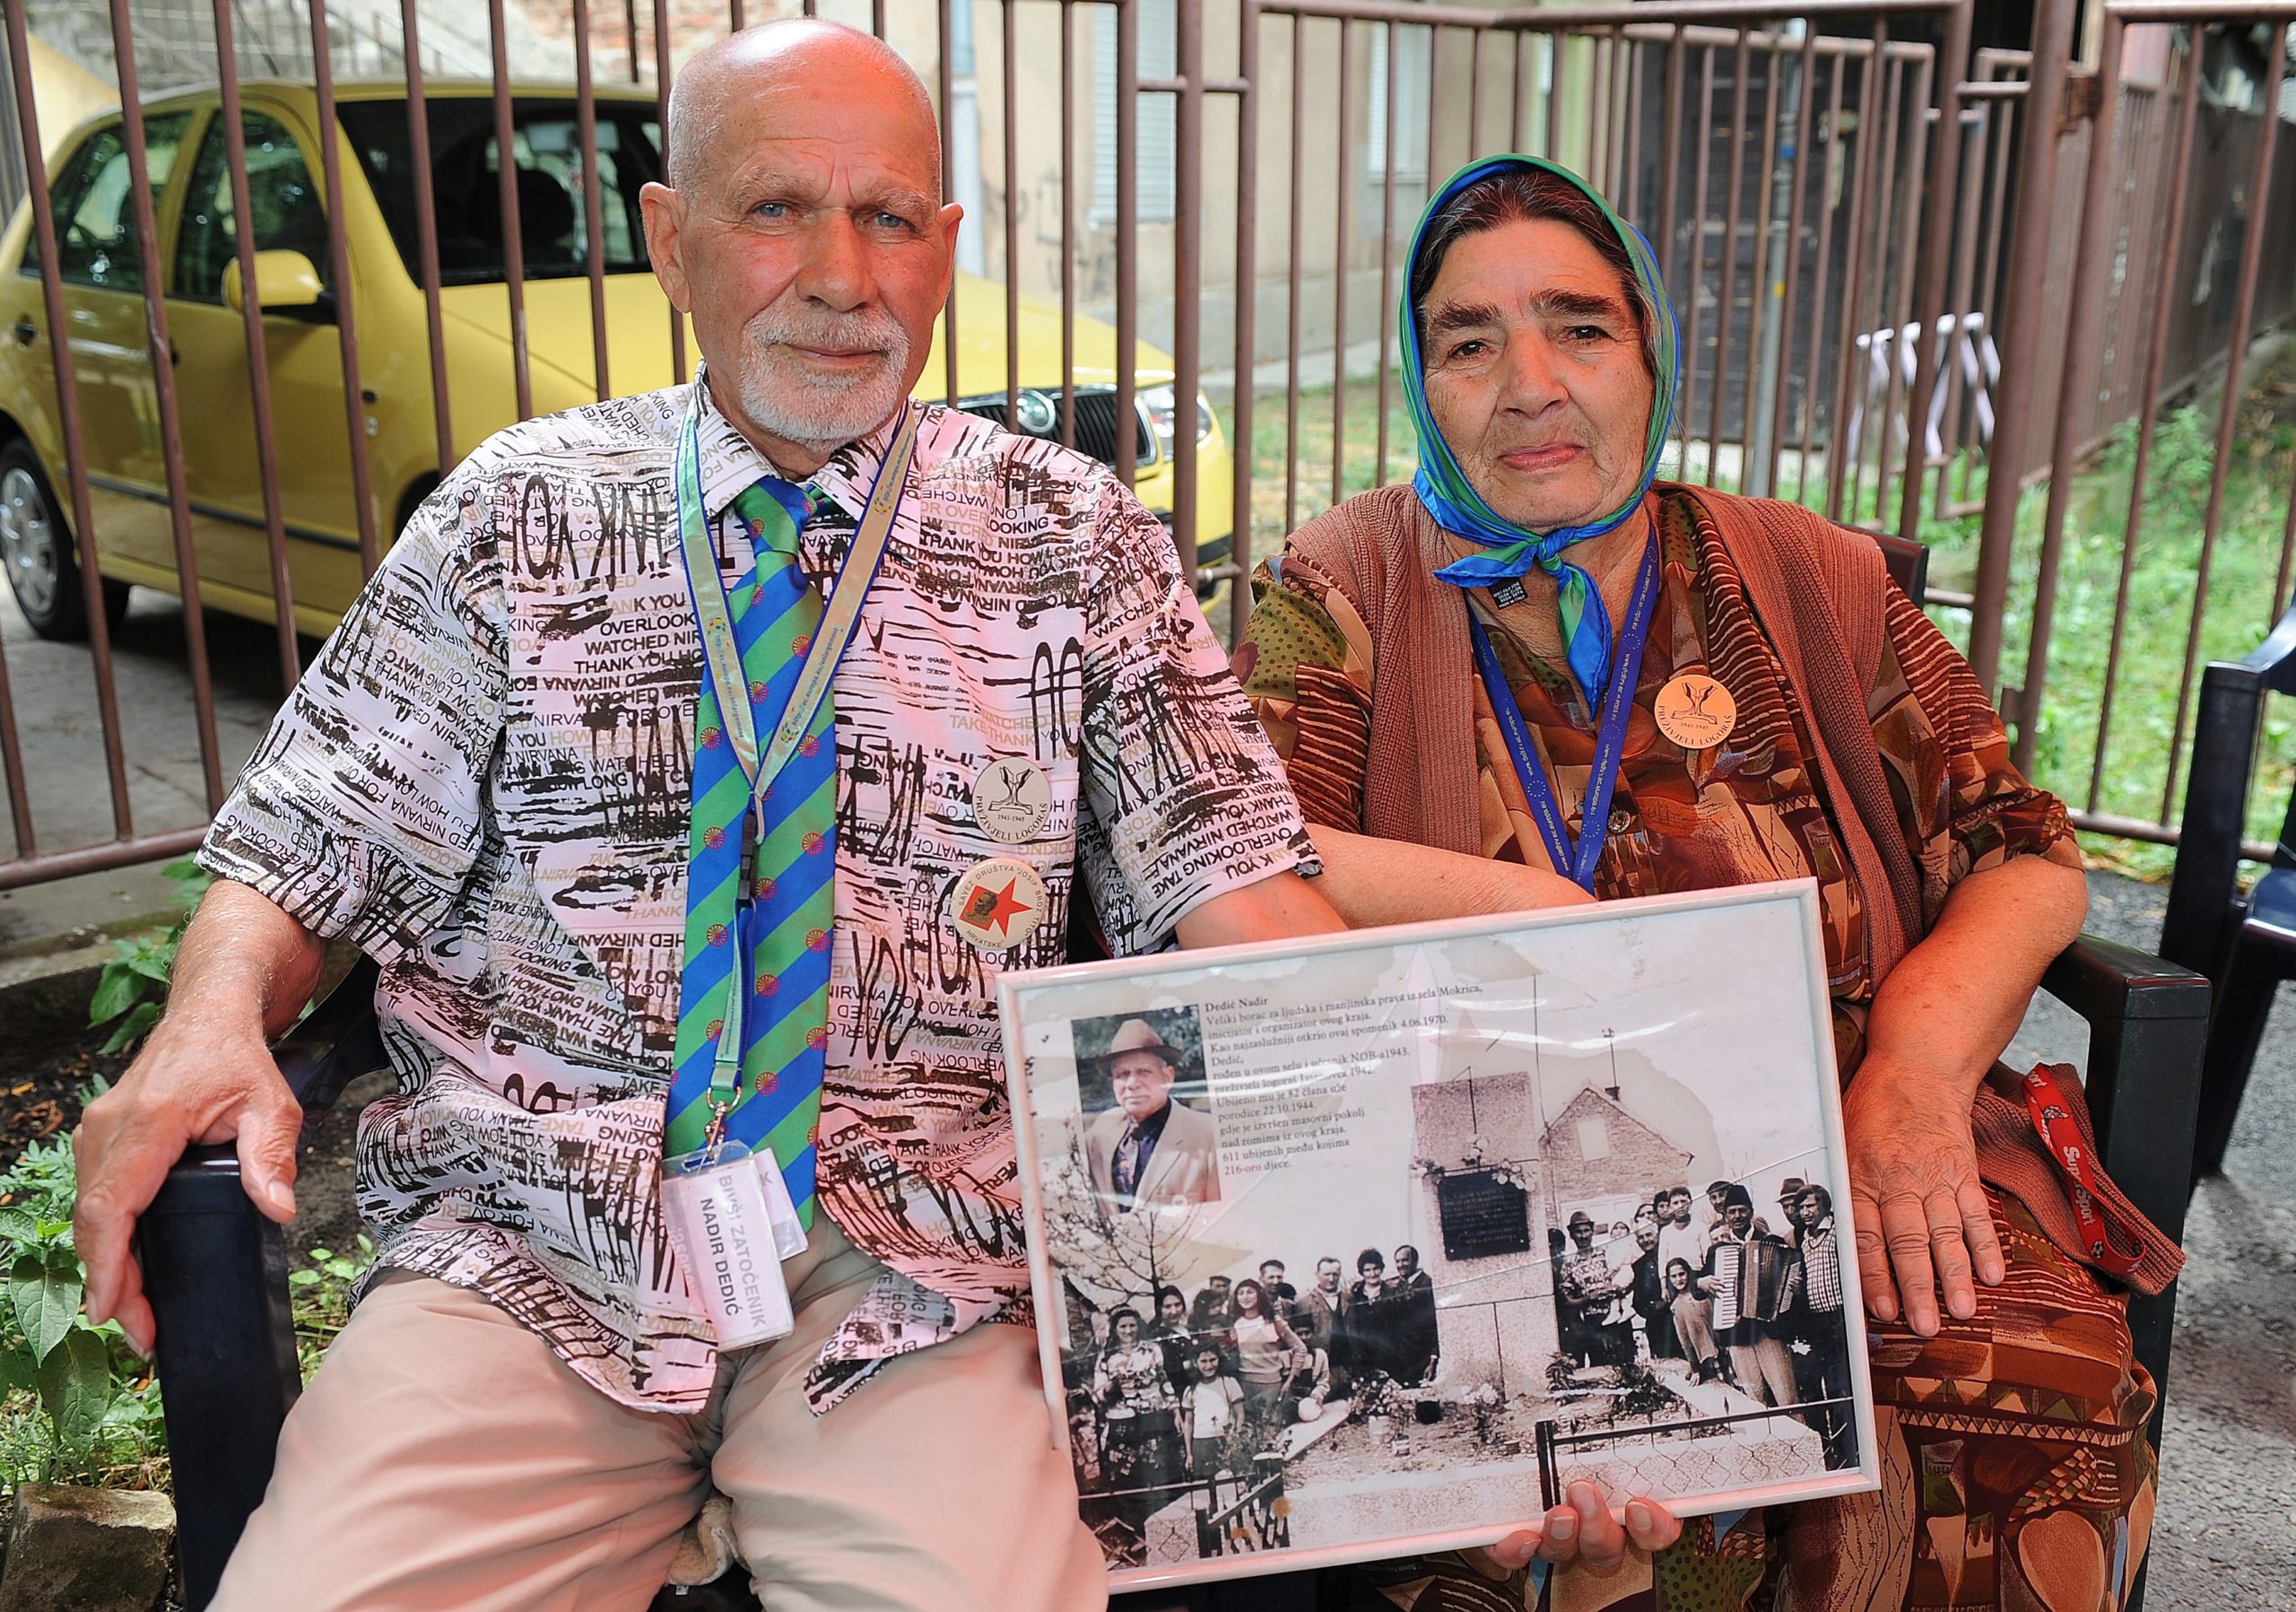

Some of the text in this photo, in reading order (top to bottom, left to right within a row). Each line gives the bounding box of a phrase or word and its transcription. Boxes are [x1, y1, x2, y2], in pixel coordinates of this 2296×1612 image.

[647, 592, 686, 612] YOU
[1093, 600, 1155, 640] WATCHED
[585, 635, 669, 656] WATCHED
[574, 649, 674, 675] THANK YOU
[373, 658, 421, 696] THANK
[543, 675, 621, 692] NIRVANA
[518, 734, 546, 747] YOU
[516, 747, 578, 762] NIRVANA
[583, 772, 628, 790] LONG
[1251, 792, 1292, 813] THANK
[387, 797, 448, 839] NIRVANA
[996, 814, 1026, 823] 1941-1945
[1161, 809, 1294, 868] WATCHED NIRVANA
[1153, 828, 1292, 898] OVERLOOKING TAKE
[1226, 860, 1260, 880] YOU
[959, 880, 975, 907] SAVEZ
[975, 865, 1014, 881] DRUŠTVA
[1034, 890, 1043, 912] BROZ
[491, 901, 516, 913] TAKE
[528, 940, 561, 954] LONG
[1206, 1015, 1237, 1025] Veliki
[1239, 1011, 1266, 1022] borac
[1326, 997, 1376, 1012] manjinska
[1378, 994, 1405, 1006] prava
[1418, 989, 1436, 999] sela
[1239, 997, 1268, 1008] Nadir
[1208, 1027, 1253, 1040] inicijator
[1261, 1019, 1317, 1033] organizator
[1319, 1015, 1344, 1027] ovog
[1345, 1013, 1371, 1024] kraja.
[915, 1033, 978, 1051] NIRVANA
[1211, 1043, 1231, 1054] Kao
[1297, 1031, 1327, 1041] otkrio
[1329, 1028, 1349, 1039] ovaj
[1352, 1021, 1398, 1035] spomenik
[1253, 1065, 1281, 1074] ovom
[1283, 1060, 1302, 1070] selu
[1216, 1094, 1256, 1109] Ubijeno
[1258, 1094, 1275, 1102] mu
[1277, 1092, 1285, 1102] je
[1289, 1089, 1300, 1099] 82
[457, 1107, 488, 1123] YOU
[1218, 1101, 1318, 1122] porodice 22.10.1944.
[1220, 1124, 1240, 1137] gdje
[1242, 1123, 1251, 1135] je
[1292, 1115, 1332, 1126] masovni
[1335, 1107, 1365, 1121] pokolj
[1222, 1125, 1347, 1148] nad romima iz ovog kraja.
[416, 1140, 462, 1160] THANK
[894, 1142, 930, 1156] TAKE
[1222, 1152, 1239, 1163] 611
[1242, 1146, 1283, 1160] ubijenih
[1316, 1138, 1350, 1152] kojima
[1224, 1159, 1292, 1176] 216-oro djece.
[700, 1198, 739, 1317] NADIR DEDIĆ
[730, 1226, 767, 1328] ZATOČENIK
